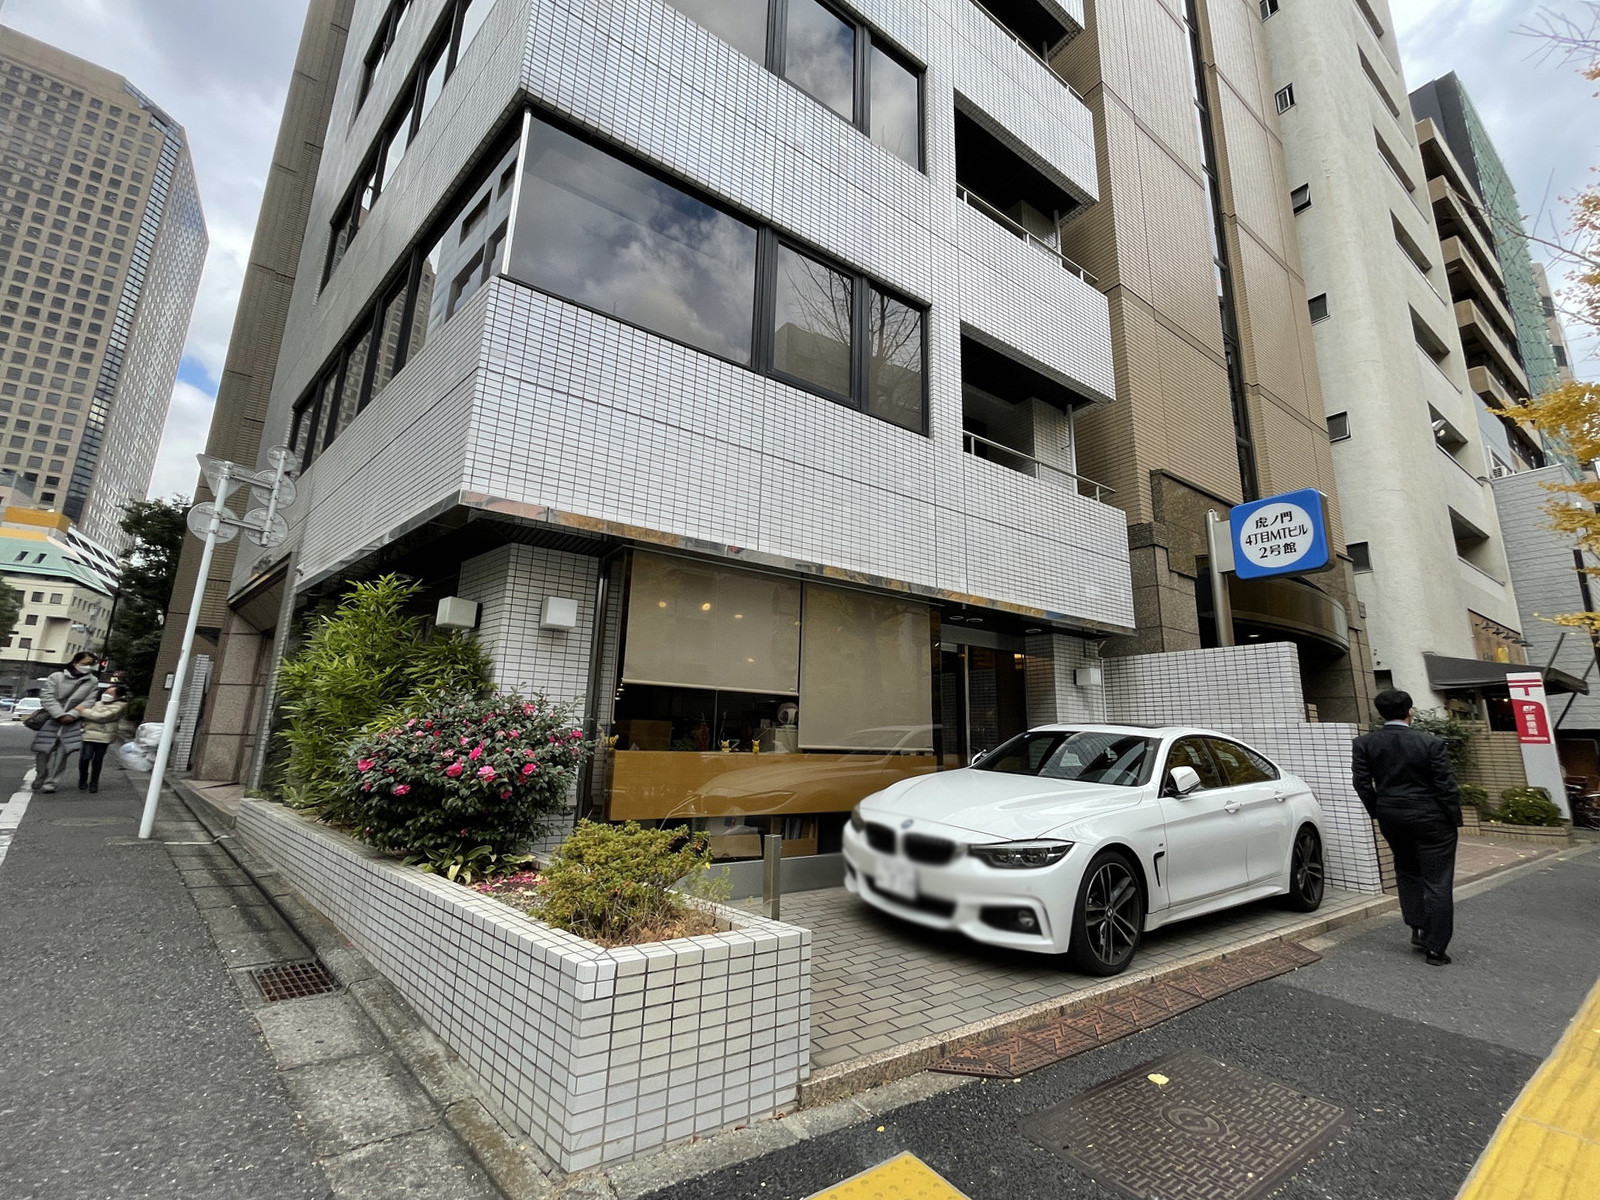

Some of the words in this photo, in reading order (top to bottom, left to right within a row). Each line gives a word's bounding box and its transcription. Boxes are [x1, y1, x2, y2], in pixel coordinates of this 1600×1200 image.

[1255, 511, 1293, 529] 虎ノ門
[1245, 524, 1308, 546] 4丁目MTビル
[1259, 542, 1297, 559] 2号館
